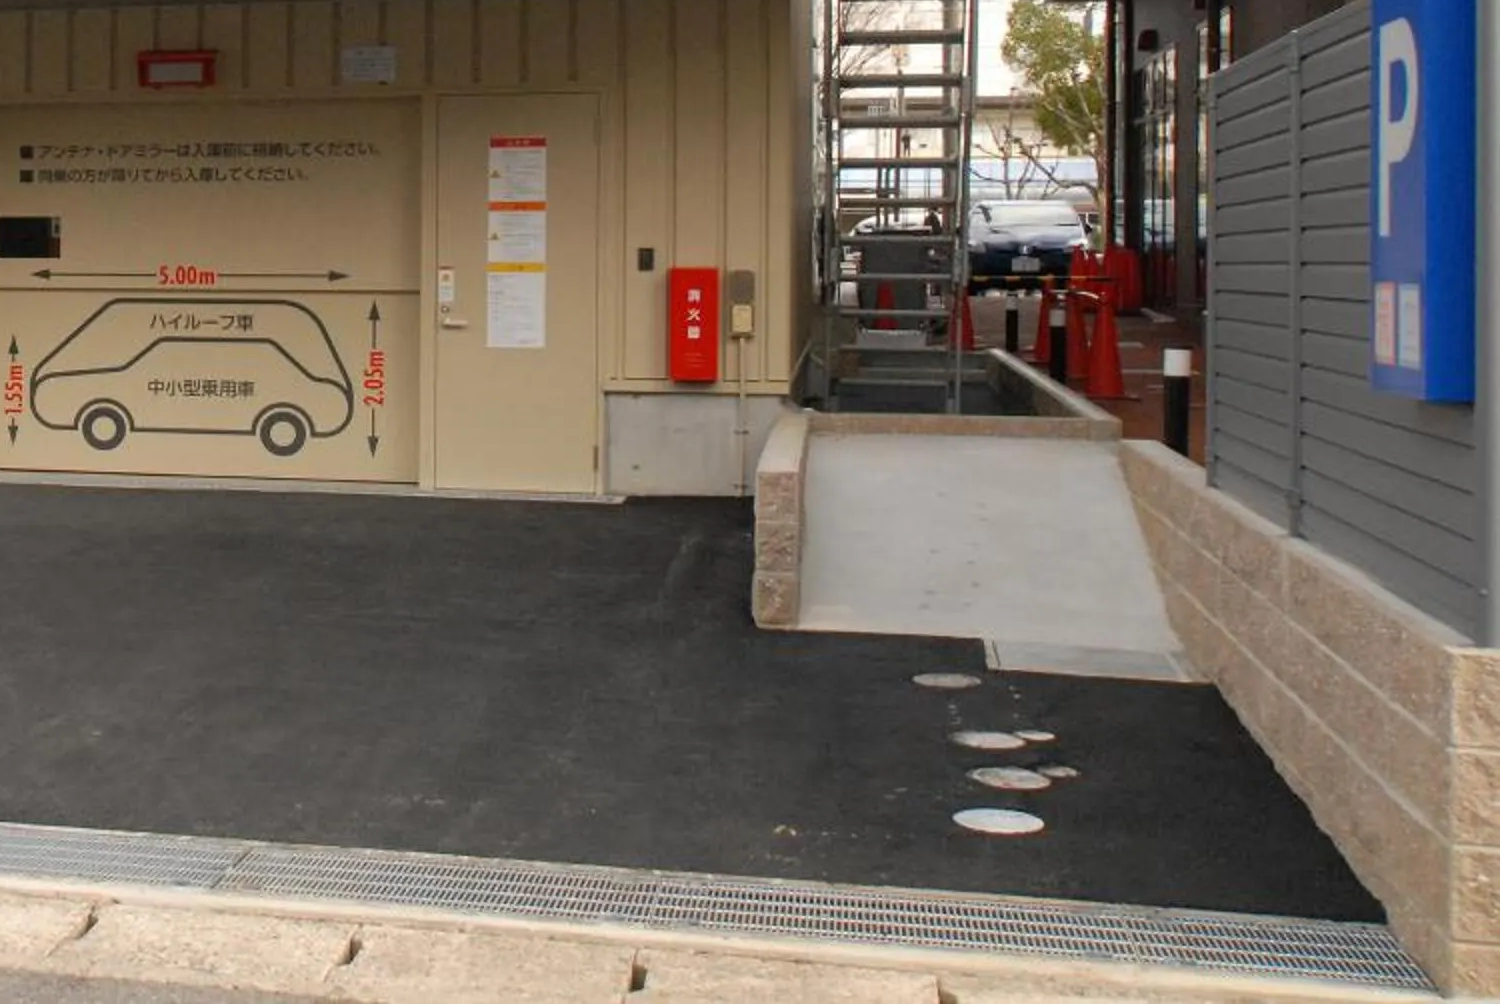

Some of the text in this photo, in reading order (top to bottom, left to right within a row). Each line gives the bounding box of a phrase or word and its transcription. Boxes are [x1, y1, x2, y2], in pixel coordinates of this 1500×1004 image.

[1379, 17, 1417, 236] P
[158, 266, 216, 285] 5.00m
[150, 313, 254, 332] ハイルーフ車
[4, 364, 22, 416] 1.55m
[148, 379, 255, 397] 中小型乗用車
[363, 350, 385, 406] 2.05m
